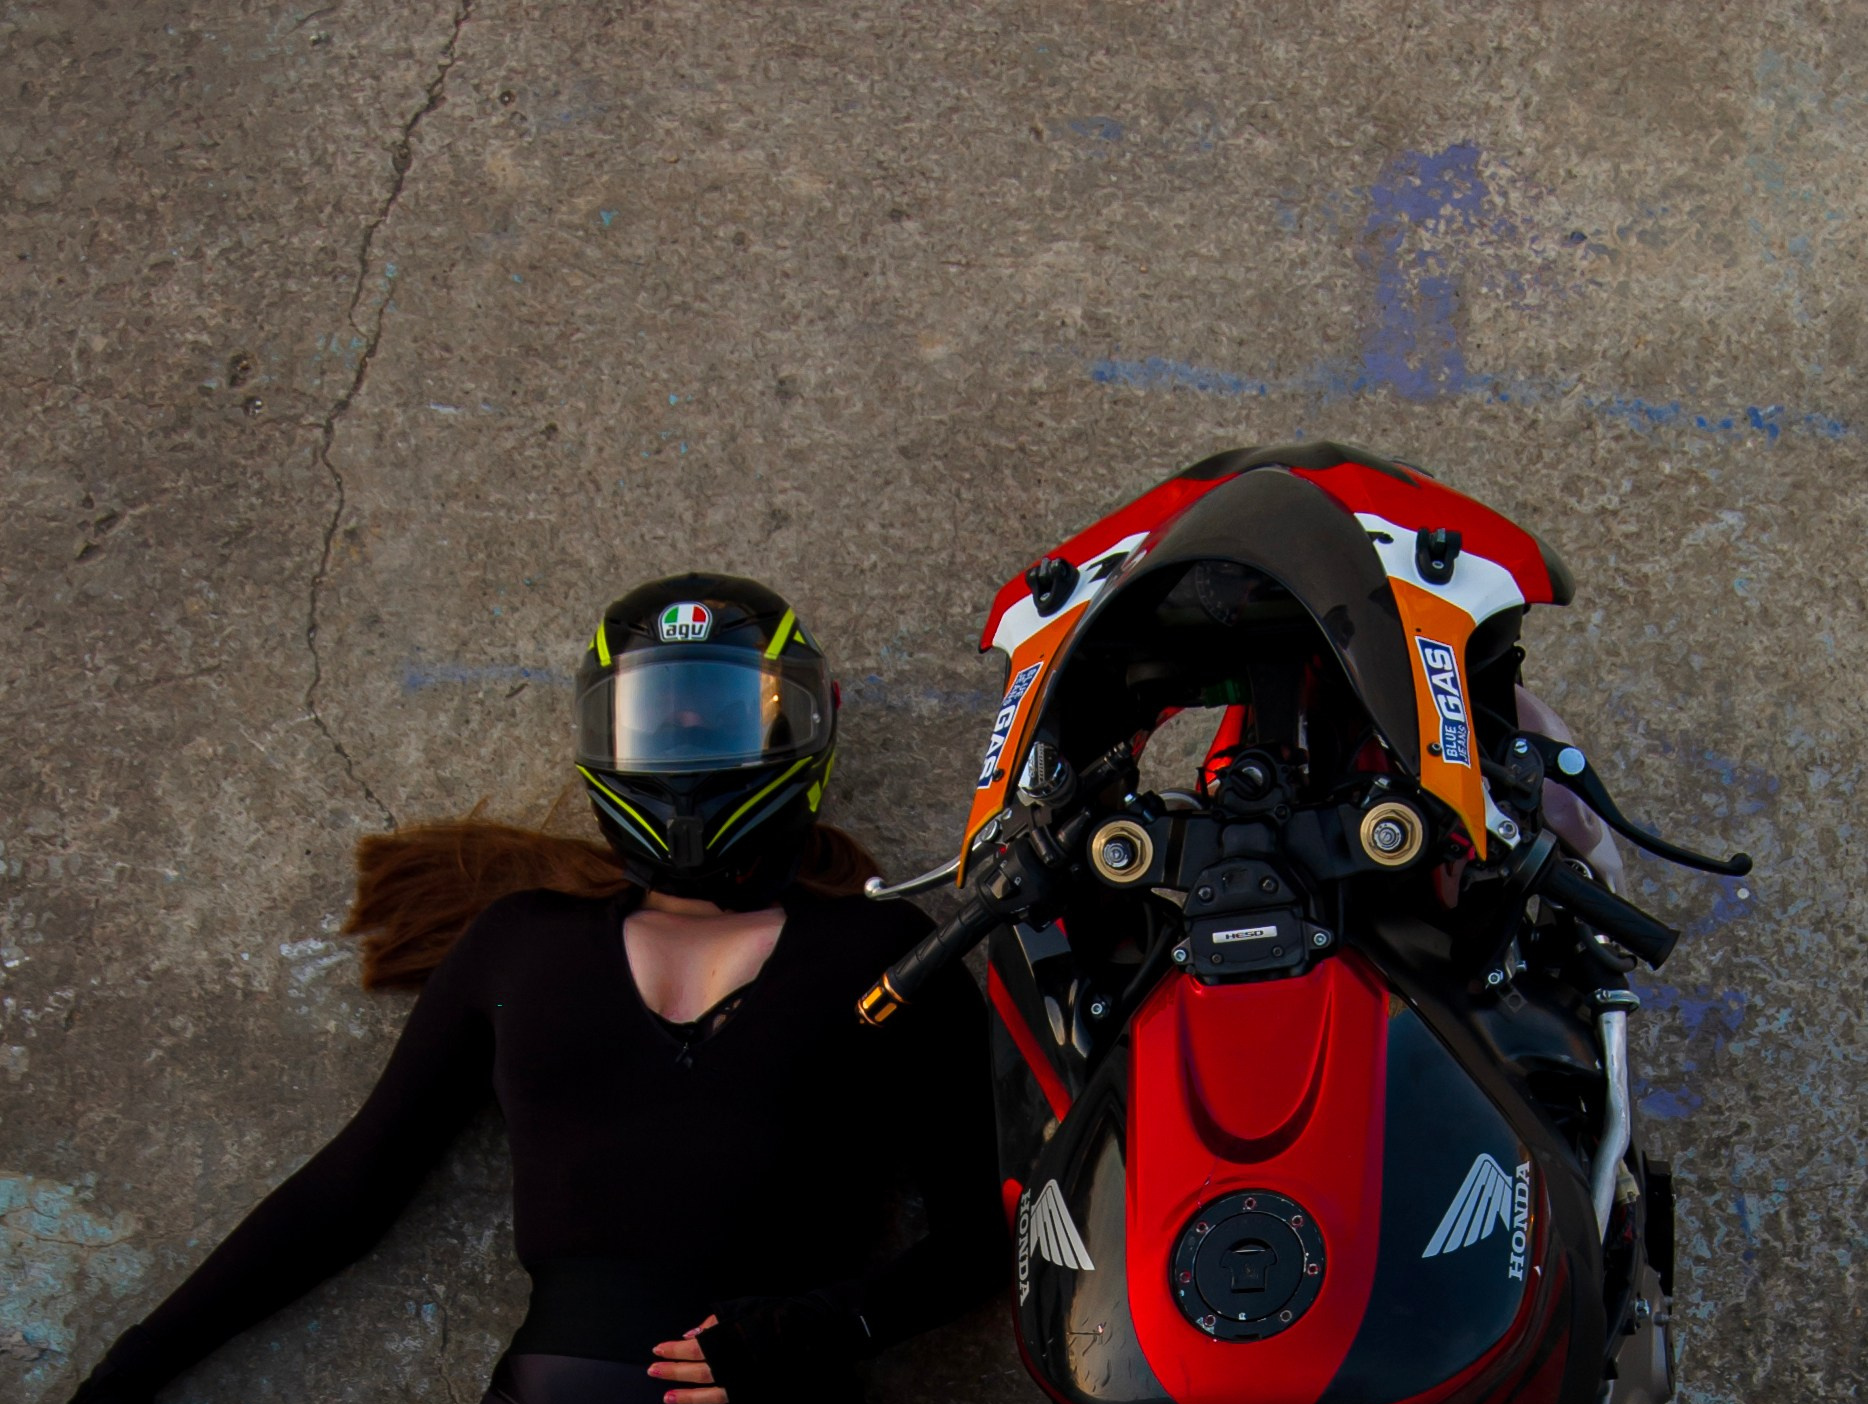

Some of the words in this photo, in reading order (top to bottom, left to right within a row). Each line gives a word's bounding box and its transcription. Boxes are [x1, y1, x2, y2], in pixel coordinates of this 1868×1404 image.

[666, 623, 704, 639] agv
[1424, 647, 1466, 723] GAS
[1444, 725, 1459, 758] BLUE
[1457, 724, 1468, 763] JEANS
[1018, 1188, 1031, 1308] HONDA
[1508, 1160, 1531, 1282] HONDA
